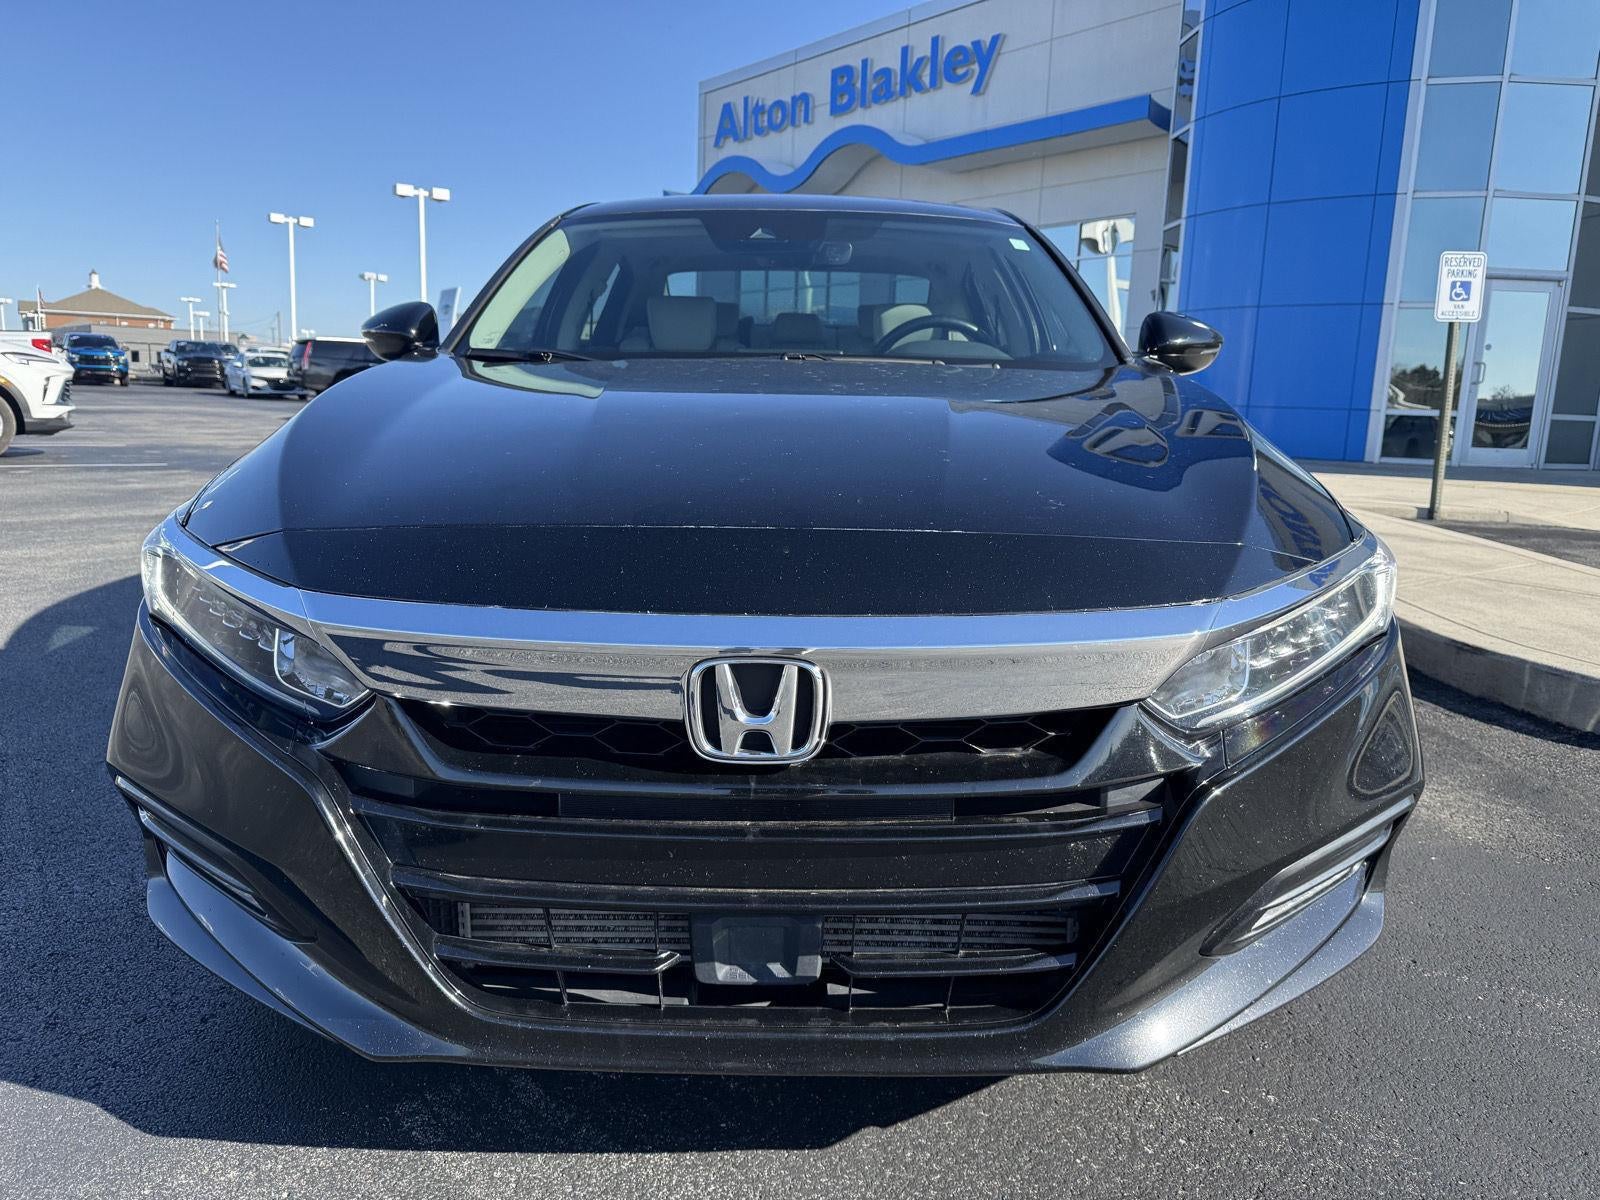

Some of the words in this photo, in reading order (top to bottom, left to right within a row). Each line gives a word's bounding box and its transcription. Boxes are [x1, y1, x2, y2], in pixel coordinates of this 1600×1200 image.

[713, 92, 814, 148] Alton
[830, 33, 1003, 116] Blakley
[1444, 257, 1482, 267] RESERVED
[1447, 268, 1477, 278] PARKING
